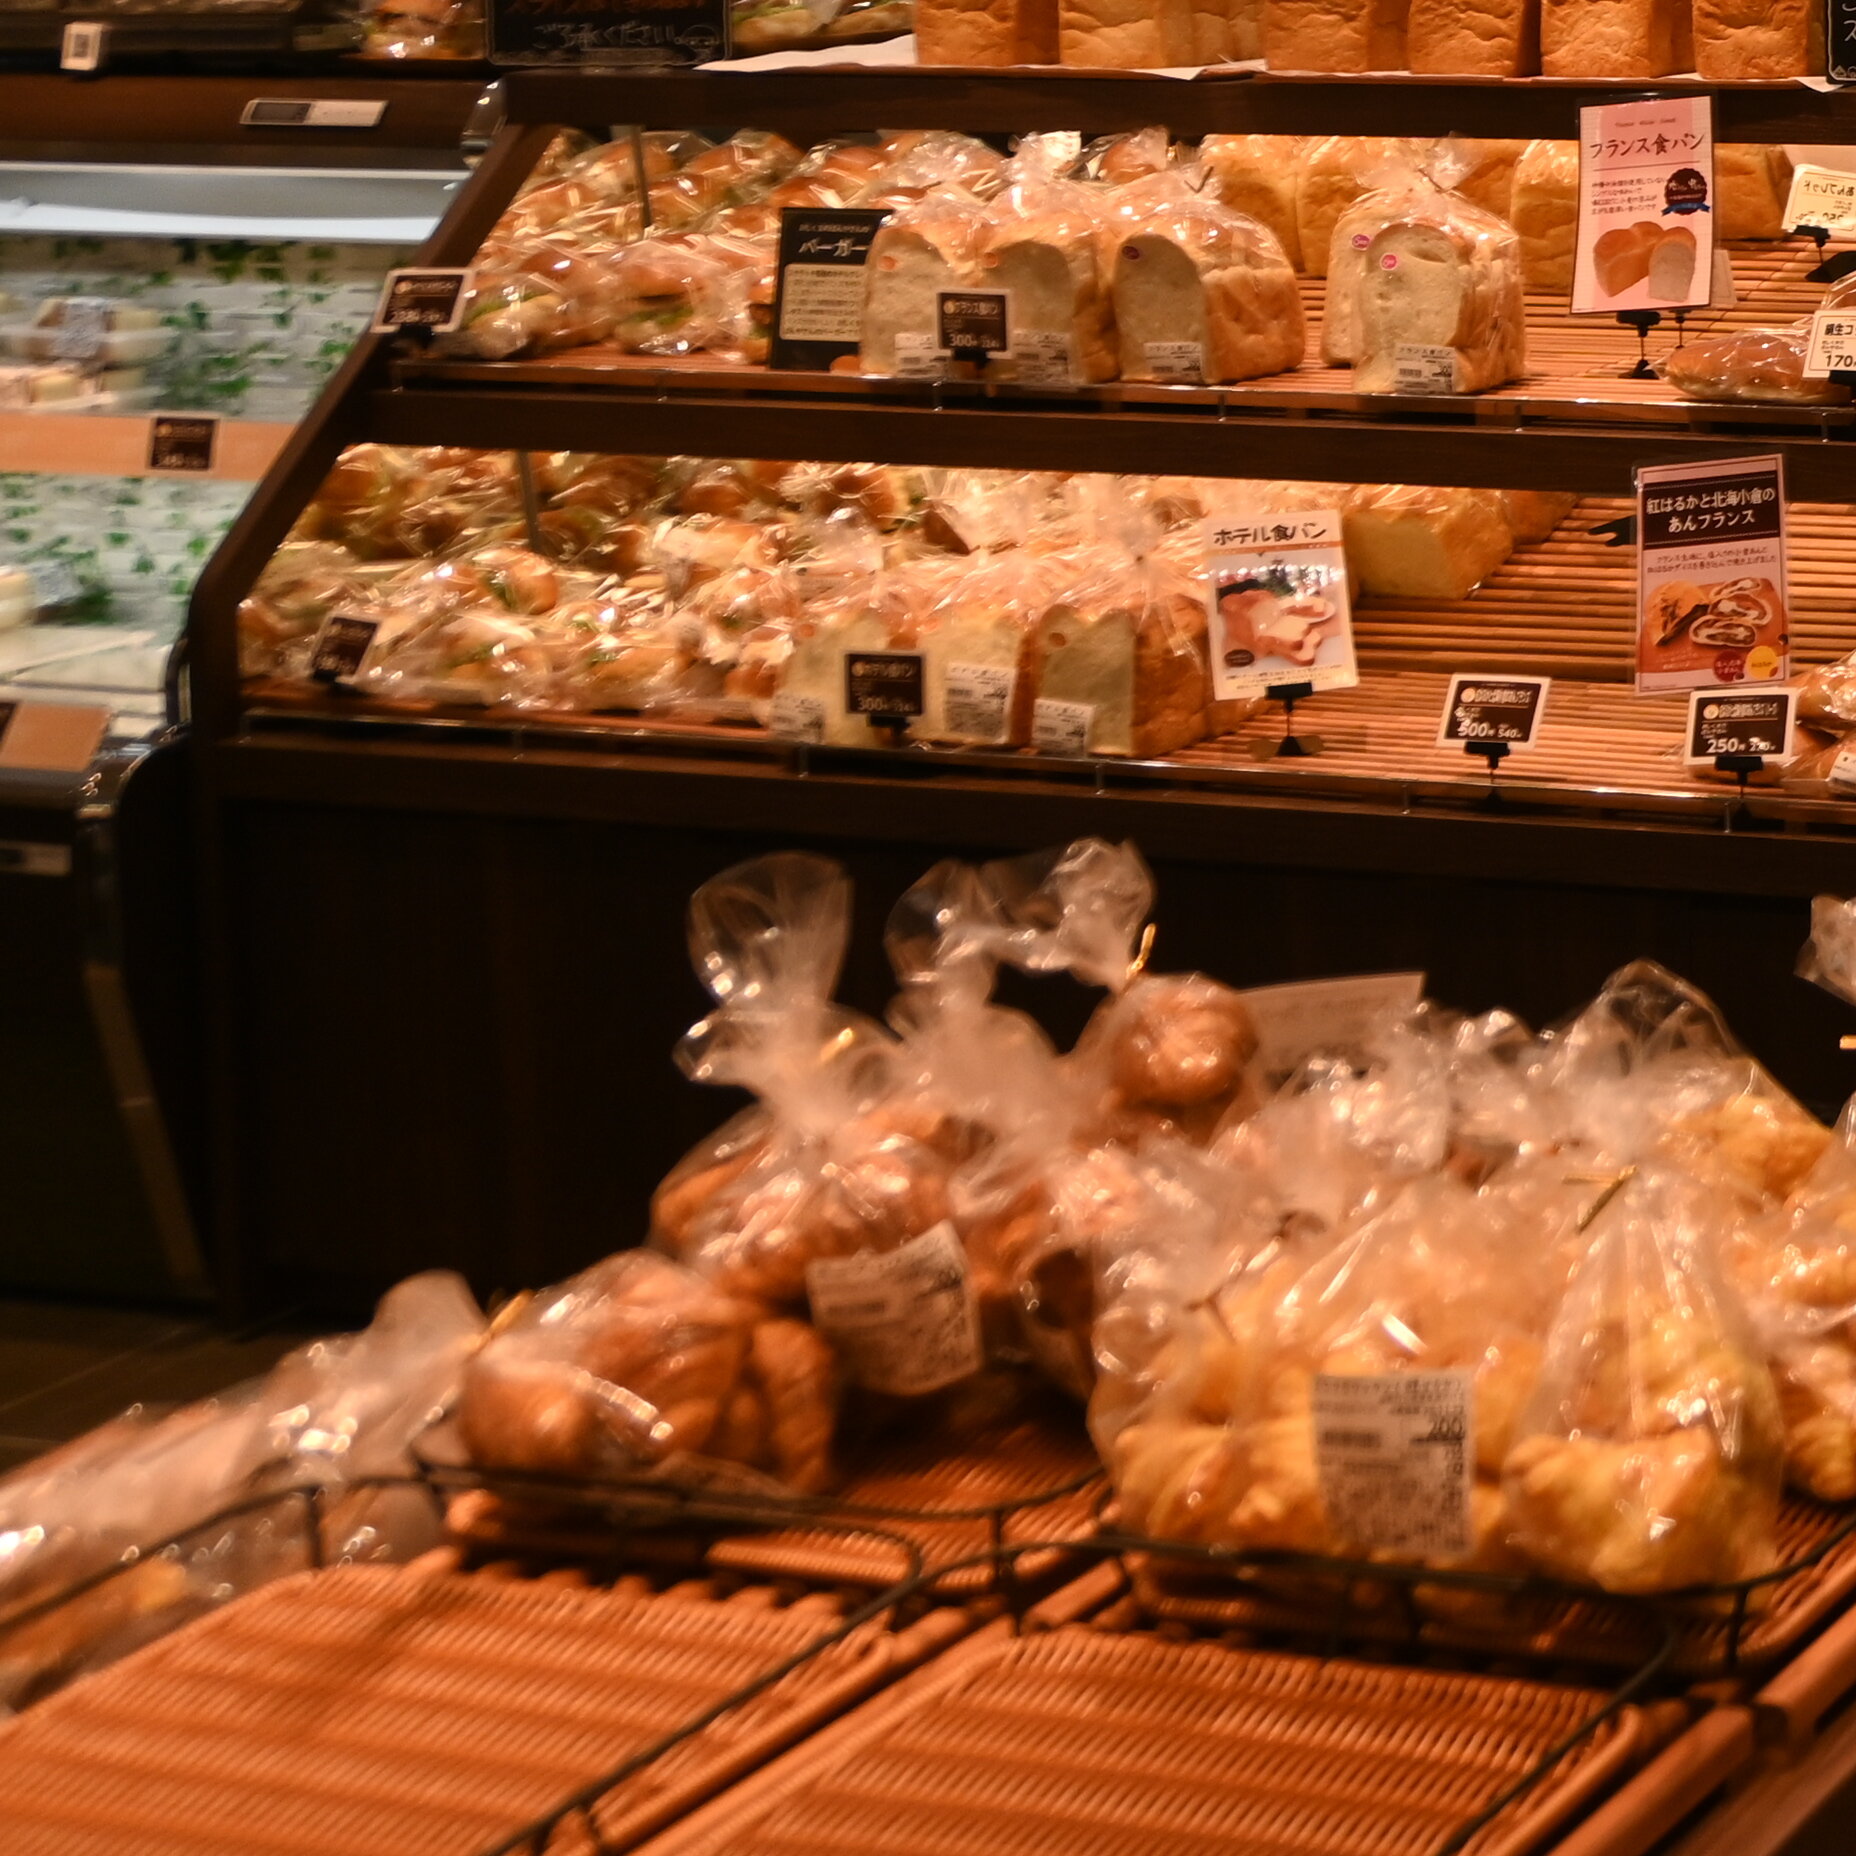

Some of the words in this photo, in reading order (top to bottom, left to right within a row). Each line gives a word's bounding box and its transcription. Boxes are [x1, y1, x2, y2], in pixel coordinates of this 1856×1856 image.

[1590, 132, 1704, 160] フランス食パン
[1646, 486, 1776, 514] 紅はるかと北海小倉の
[1212, 522, 1328, 546] ホテル食パン
[1668, 508, 1756, 534] あんフランス
